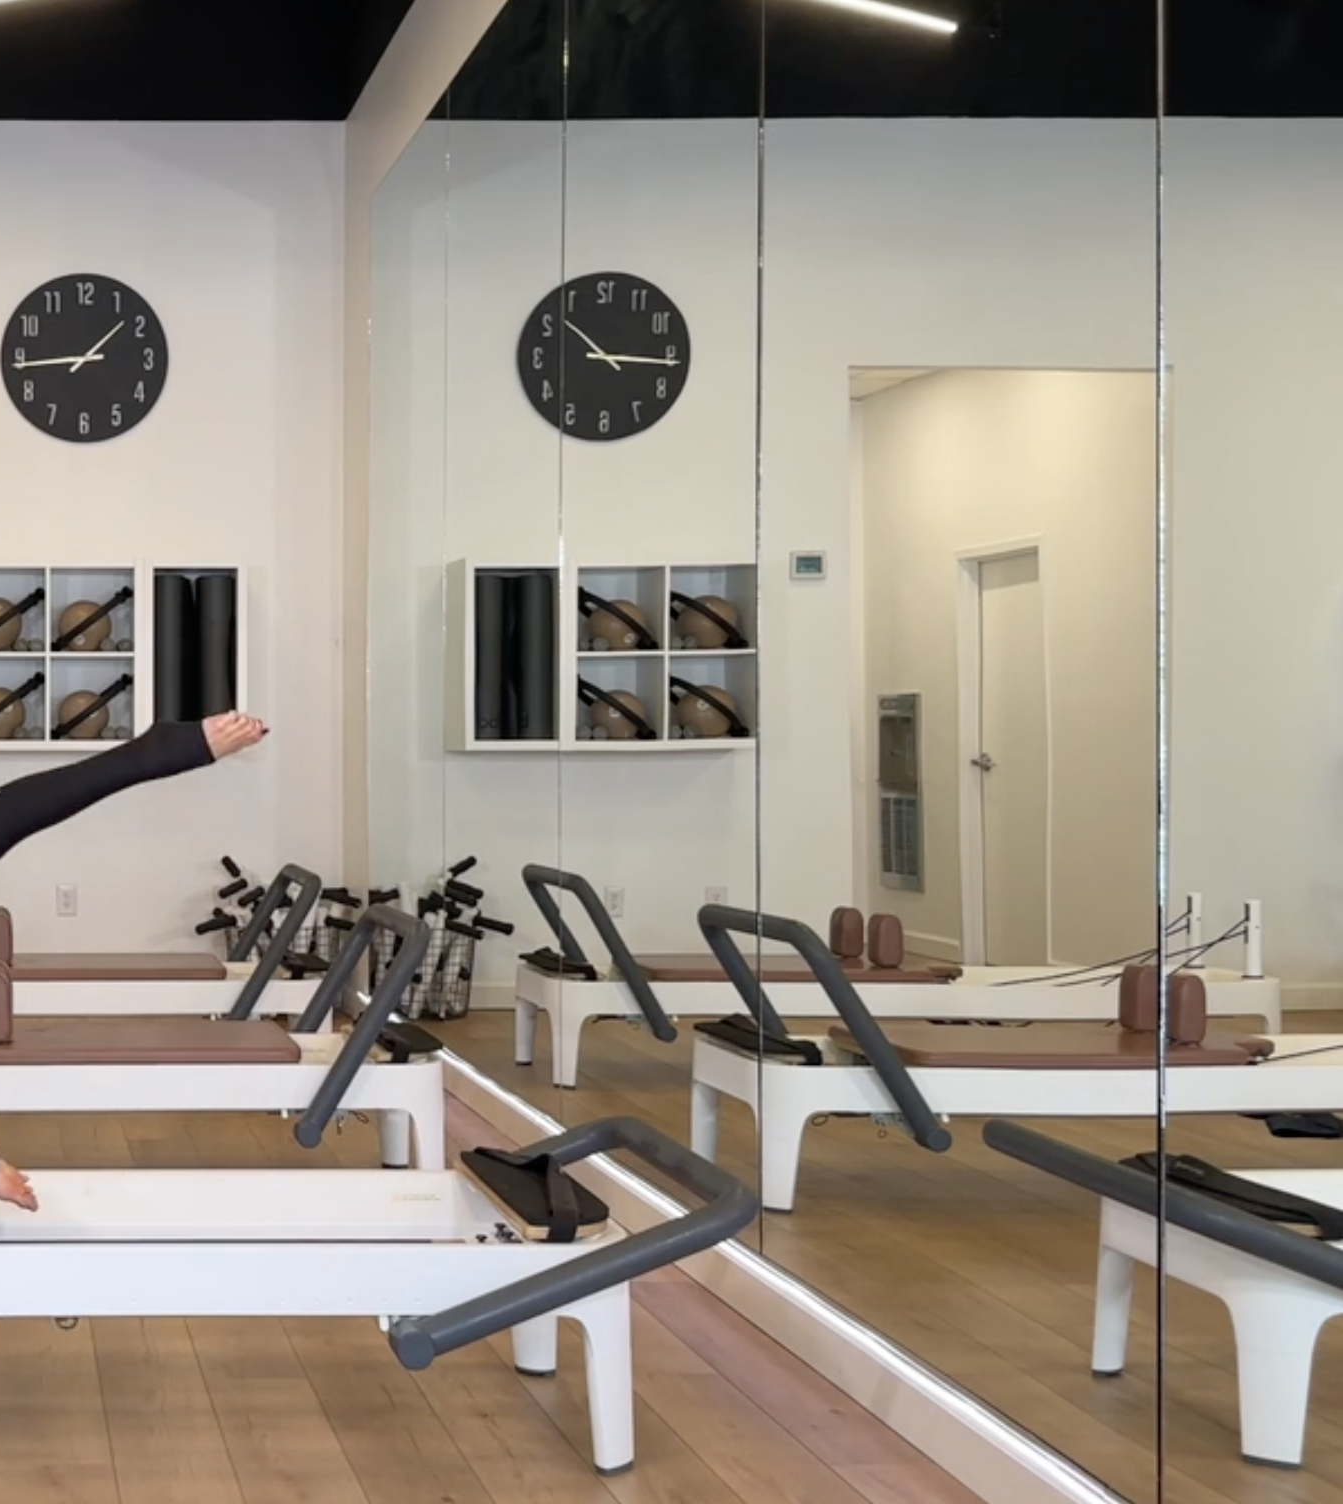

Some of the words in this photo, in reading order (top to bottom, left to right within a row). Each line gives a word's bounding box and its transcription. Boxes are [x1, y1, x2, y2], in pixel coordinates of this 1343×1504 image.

[44, 291, 61, 314] 11
[76, 282, 95, 306] 12
[113, 291, 121, 314] 1
[20, 314, 39, 337] 10
[134, 315, 146, 338] 2
[15, 347, 26, 369] 9
[143, 348, 154, 371] 3
[23, 380, 34, 402] 8
[134, 380, 145, 403] 4
[47, 403, 57, 425] 7
[79, 412, 90, 434] 6
[111, 403, 122, 427] 5
